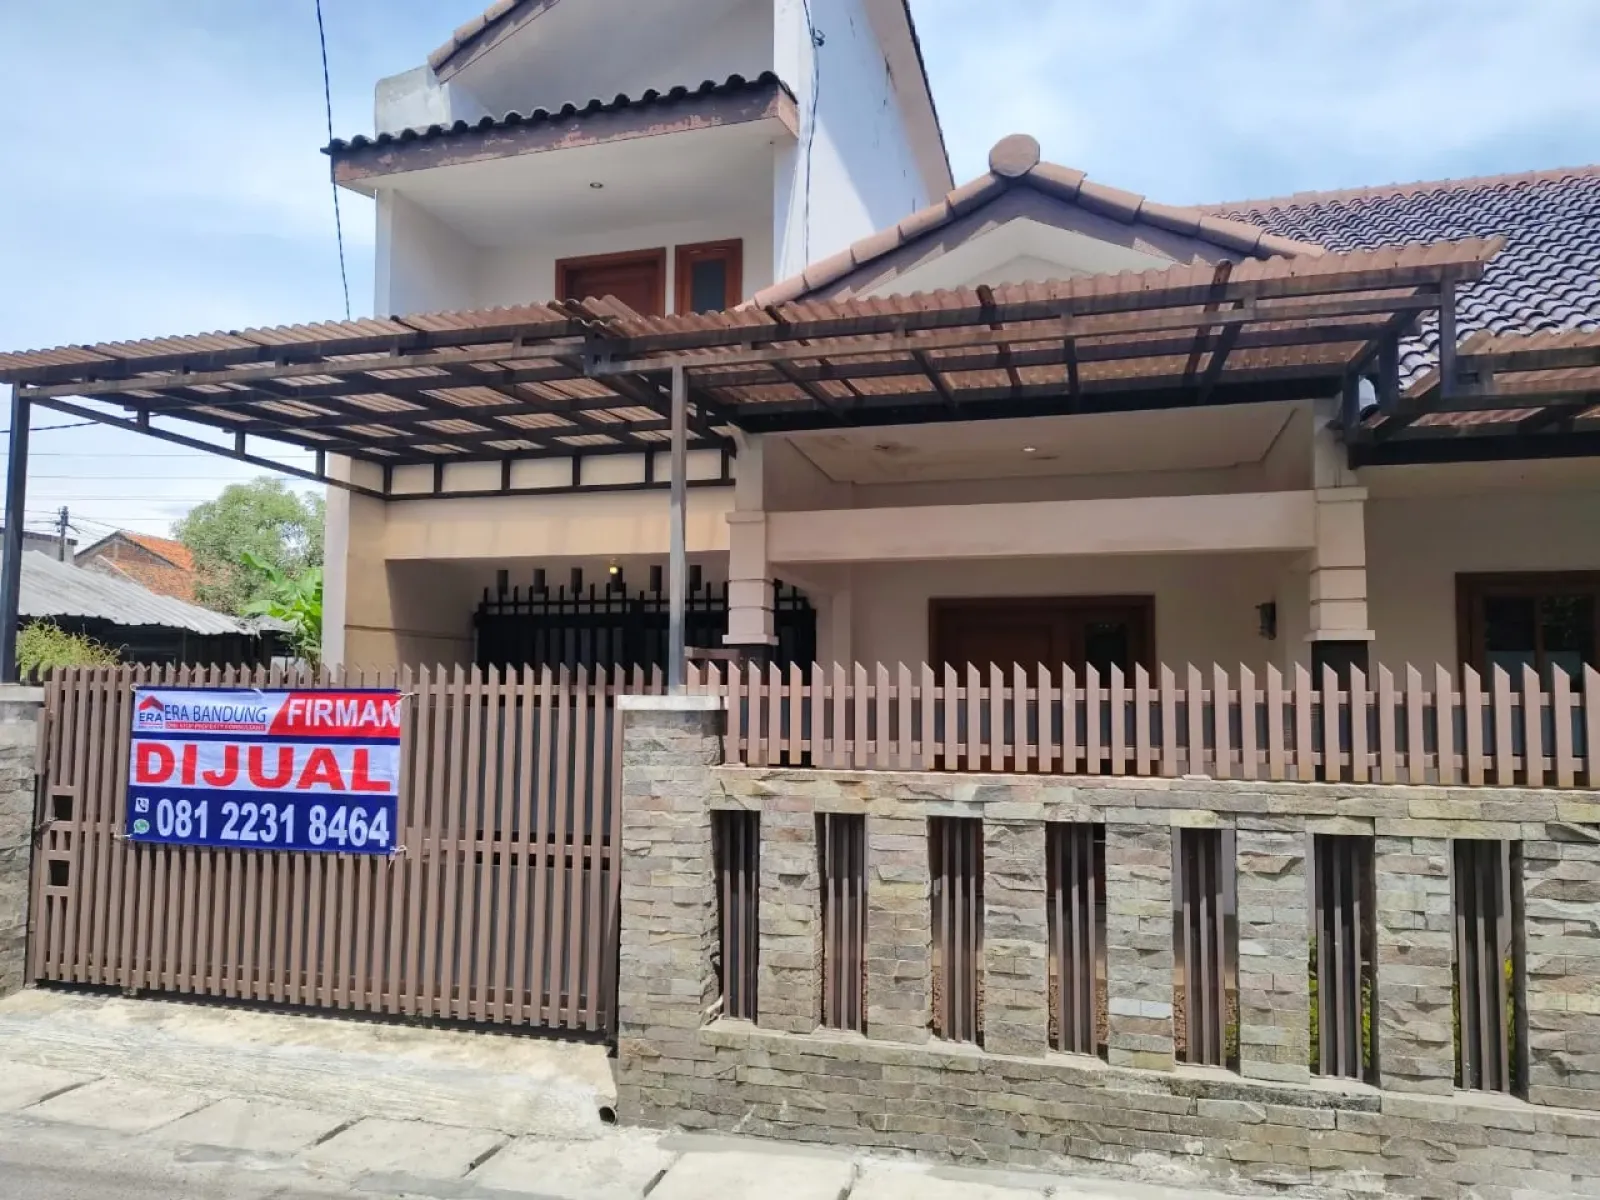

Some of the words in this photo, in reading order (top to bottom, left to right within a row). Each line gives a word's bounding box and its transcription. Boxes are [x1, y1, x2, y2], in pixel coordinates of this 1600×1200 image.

[139, 713, 162, 722] ERA
[164, 705, 189, 721] ERA
[193, 705, 268, 723] BANDUNG
[287, 699, 400, 728] FIRMAN
[136, 743, 391, 792] DIJUAL
[156, 799, 208, 838] 081
[220, 801, 295, 843] 2231
[308, 804, 390, 847] 8464
